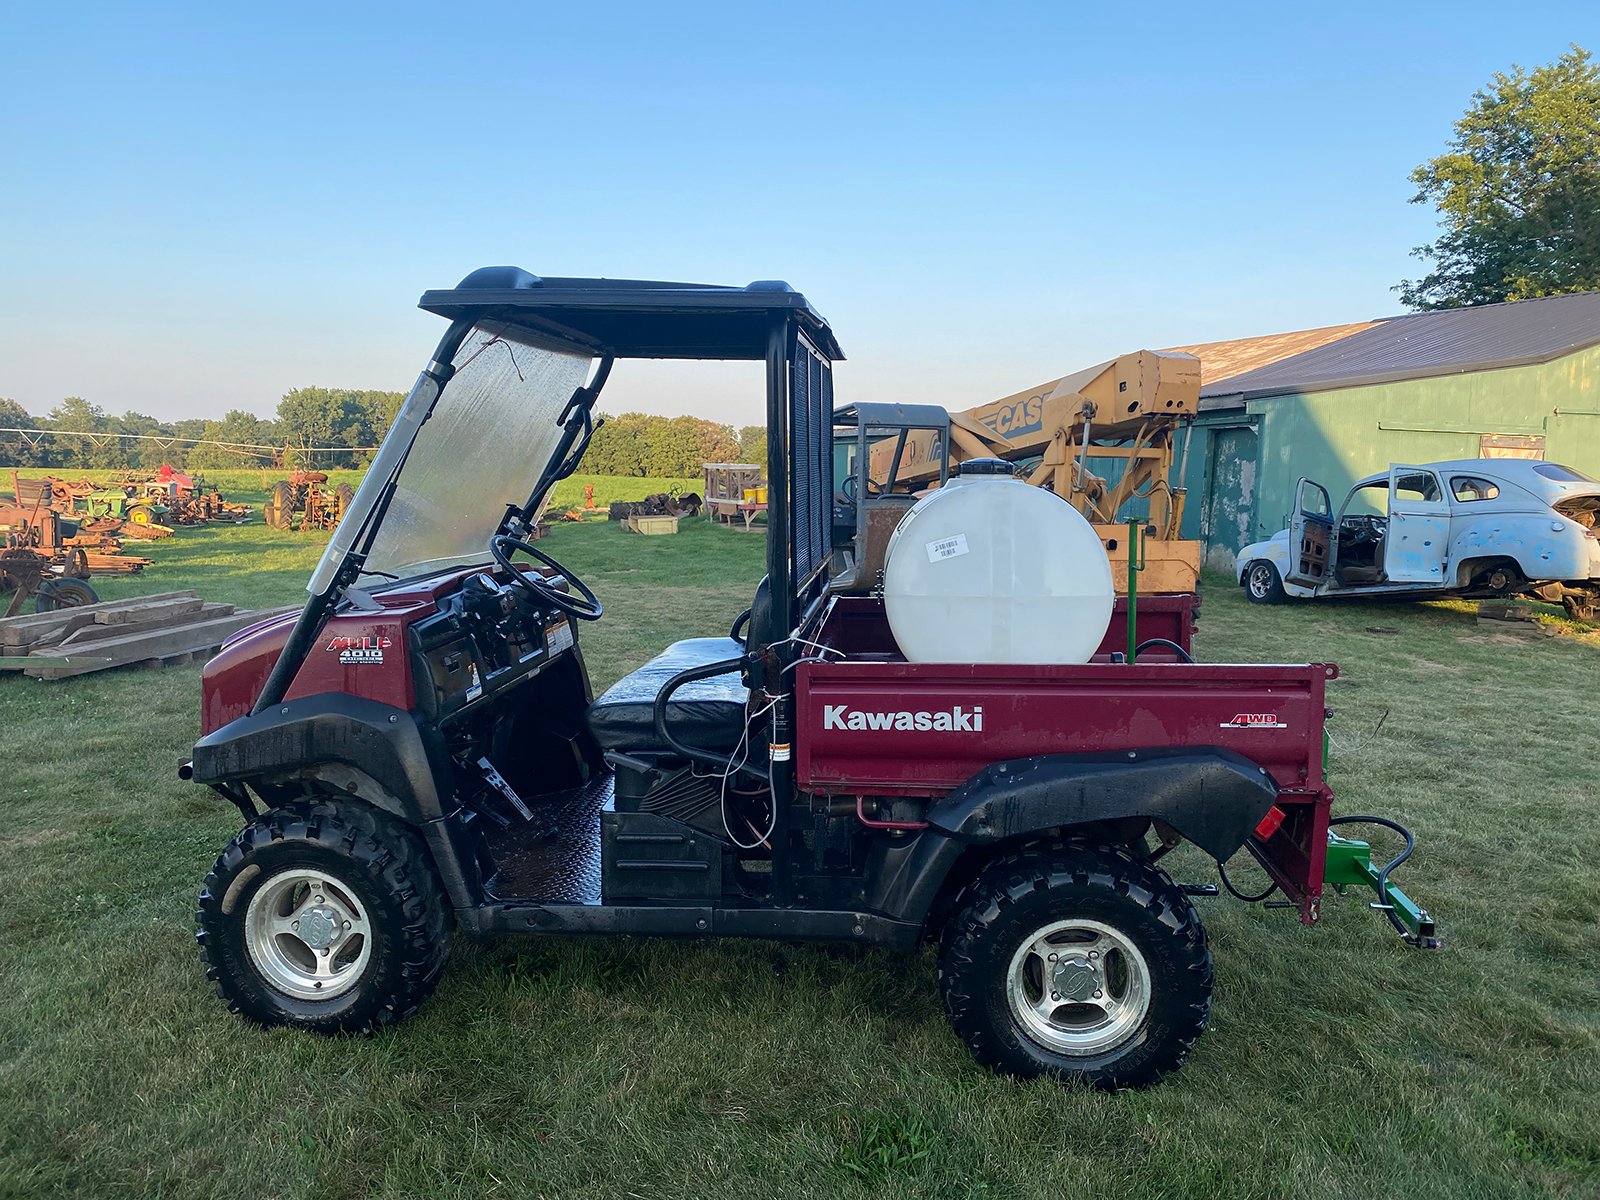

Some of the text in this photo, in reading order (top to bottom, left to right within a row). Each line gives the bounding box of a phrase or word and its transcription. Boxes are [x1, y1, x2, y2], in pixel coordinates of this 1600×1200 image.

[996, 392, 1046, 435] CAS
[824, 704, 983, 732] Kawasaki
[1230, 713, 1277, 728] 4WD
